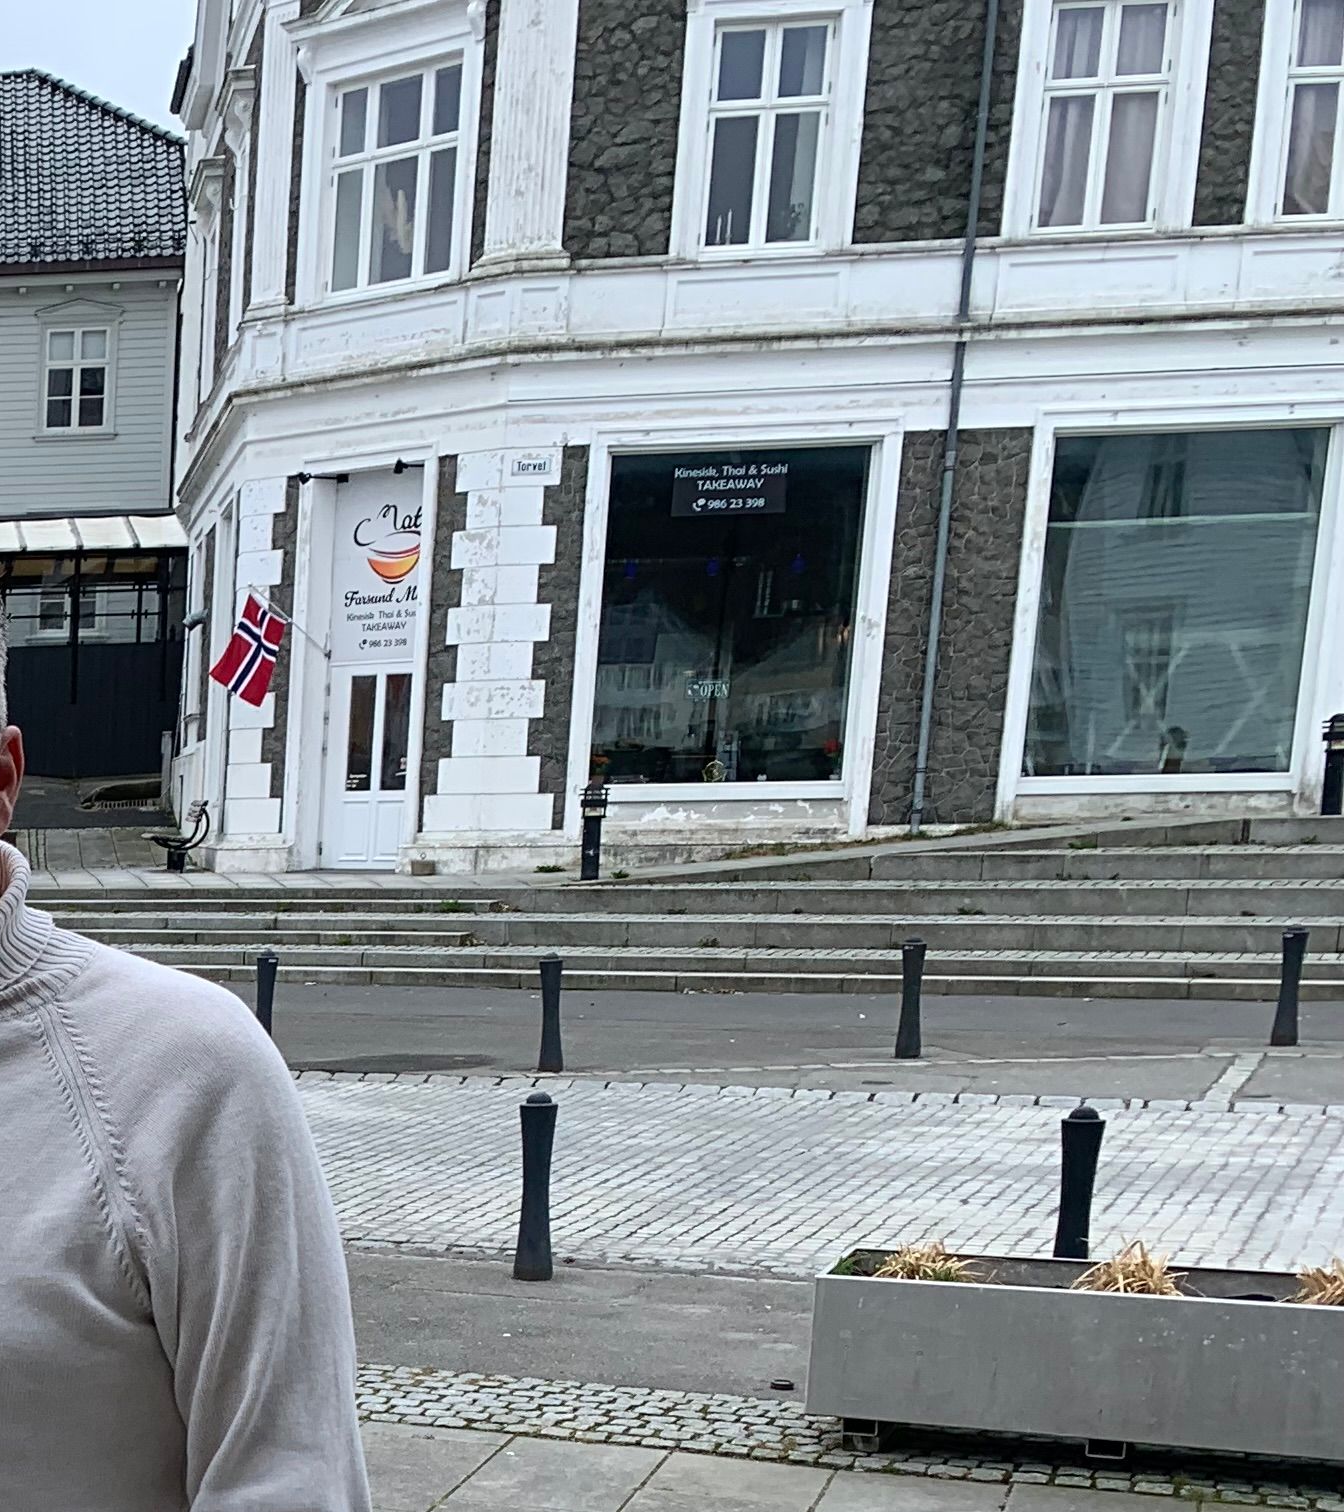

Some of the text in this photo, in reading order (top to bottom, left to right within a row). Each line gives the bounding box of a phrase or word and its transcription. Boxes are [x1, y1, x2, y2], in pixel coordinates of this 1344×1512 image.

[722, 465, 746, 476] Thai
[748, 464, 758, 475] &
[760, 464, 789, 475] Sushi
[697, 478, 765, 490] TAKEAWAY
[707, 498, 766, 509] 986 23 398
[344, 585, 418, 608] Farsund M
[361, 621, 407, 632] TAKEAWAY
[700, 683, 729, 697] OPEN
